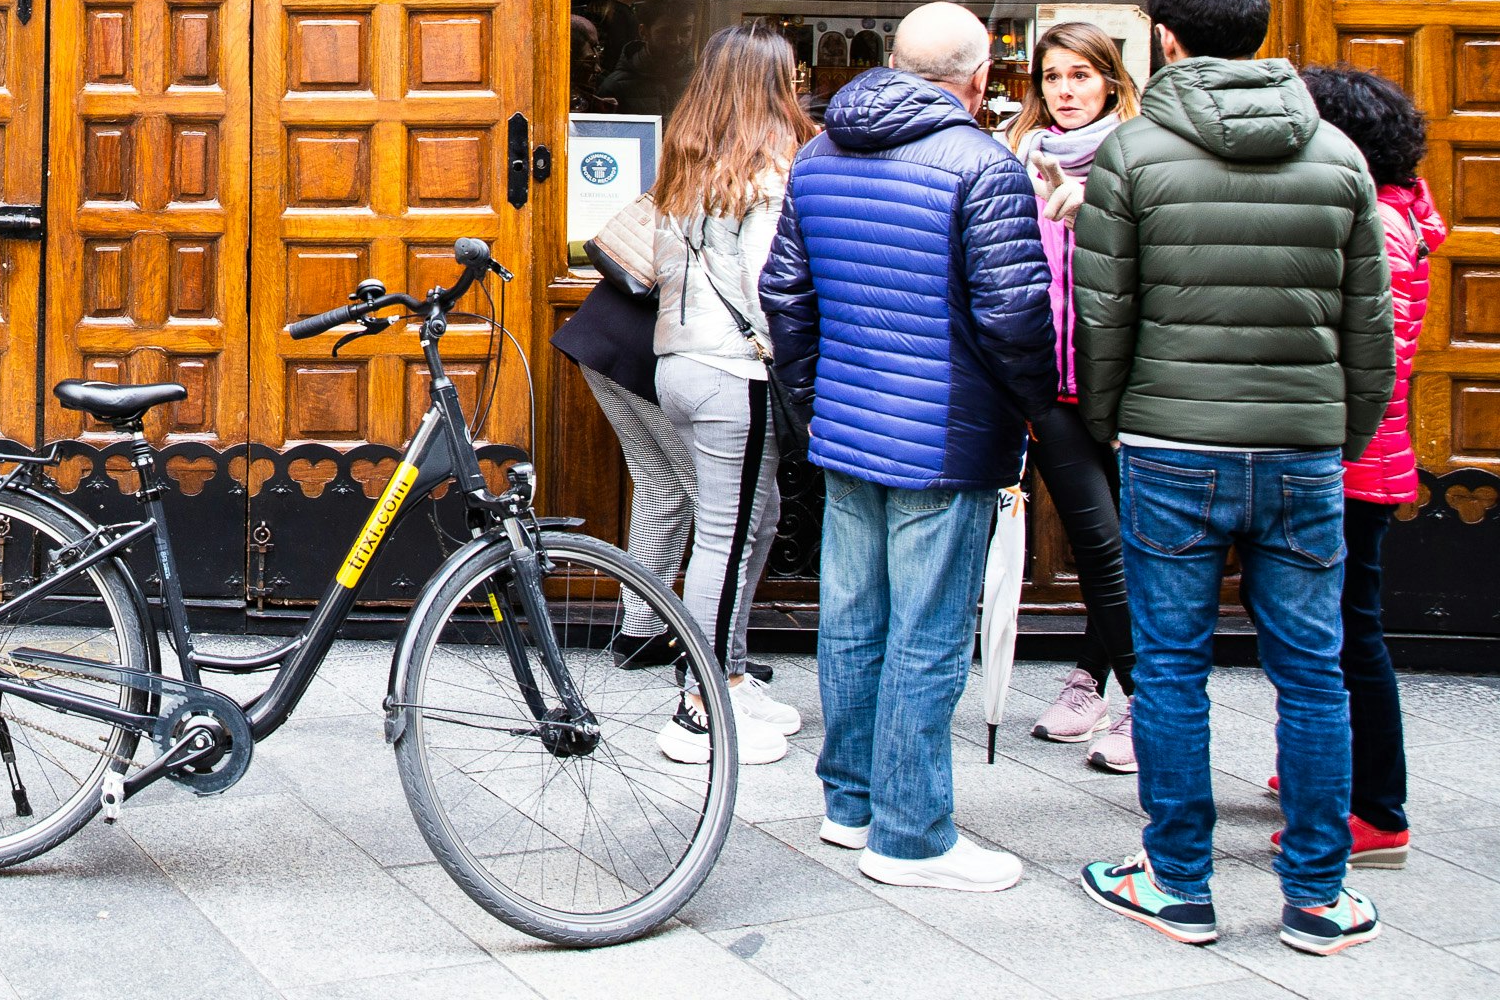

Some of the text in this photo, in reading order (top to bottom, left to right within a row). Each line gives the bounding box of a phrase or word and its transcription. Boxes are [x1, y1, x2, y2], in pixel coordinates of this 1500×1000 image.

[585, 153, 614, 164] GUINNESS
[581, 166, 617, 184] WORLD RECORDS
[347, 480, 409, 571] trixi.com
